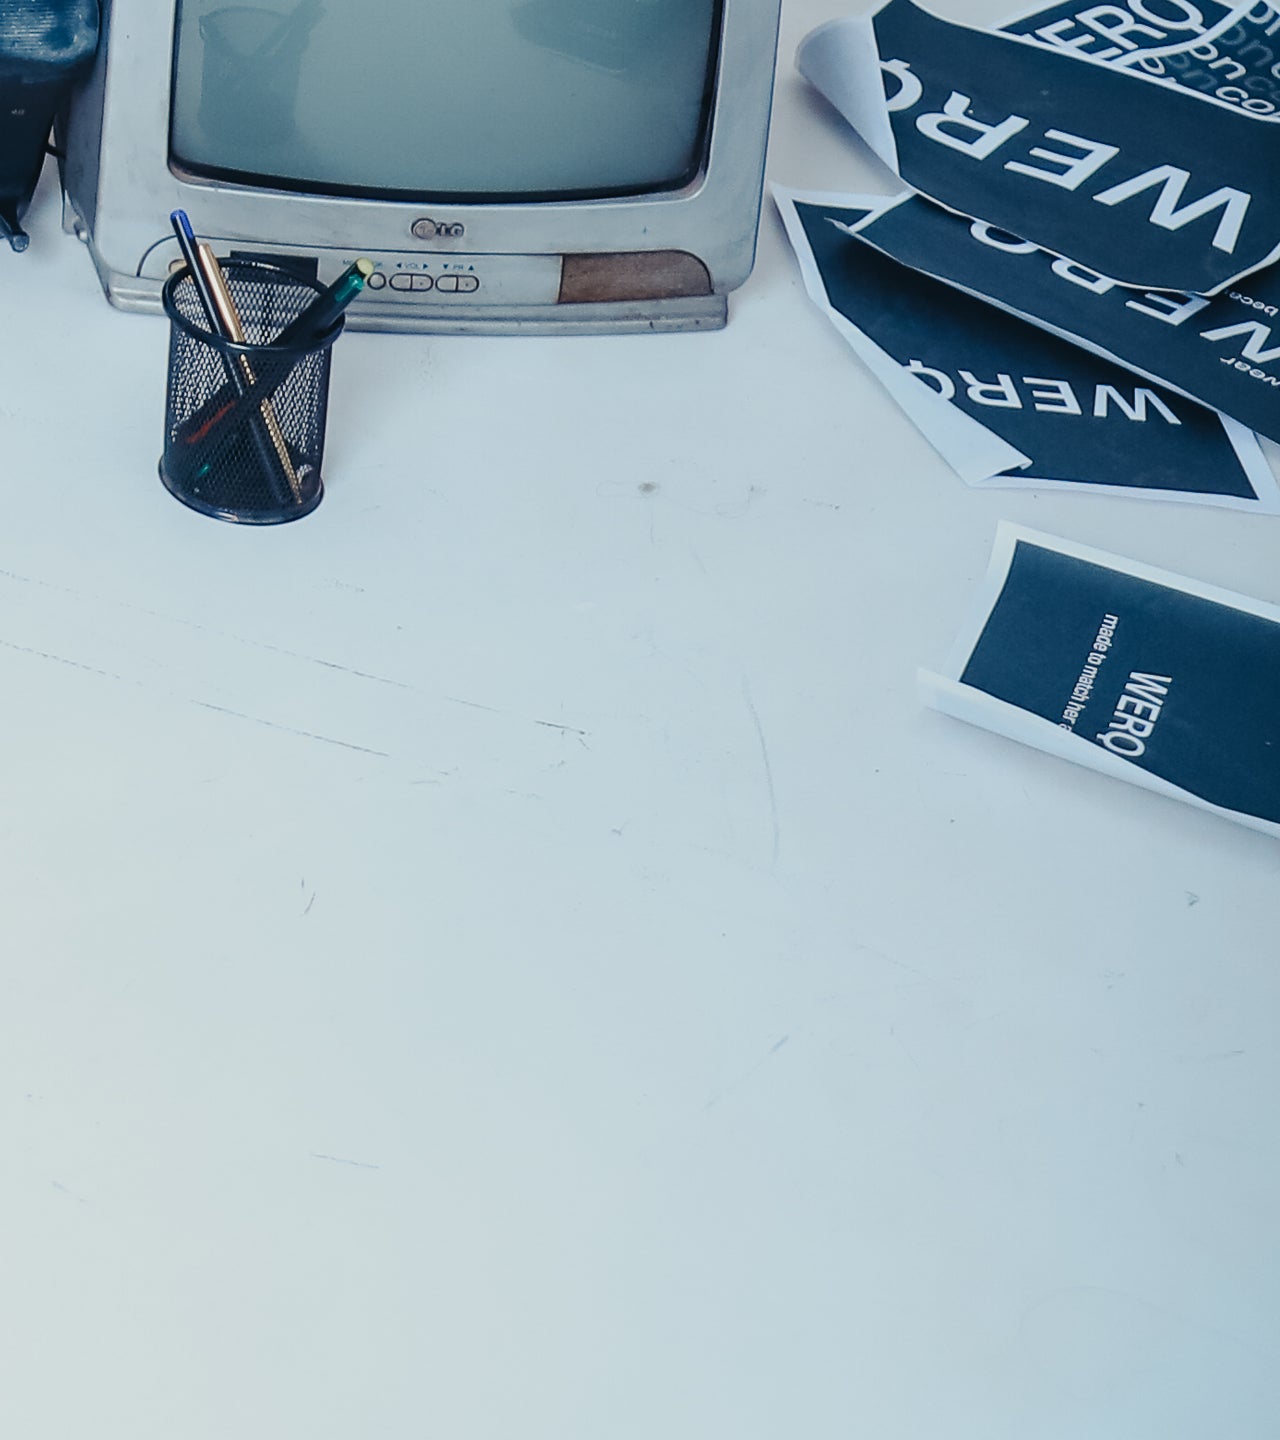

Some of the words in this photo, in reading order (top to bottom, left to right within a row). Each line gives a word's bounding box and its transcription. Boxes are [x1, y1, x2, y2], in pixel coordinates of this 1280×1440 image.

[1093, 613, 1119, 652] made
[1087, 651, 1107, 666] to
[1071, 664, 1098, 704] match
[1062, 700, 1087, 725] her
[1096, 671, 1172, 757] WERQ
